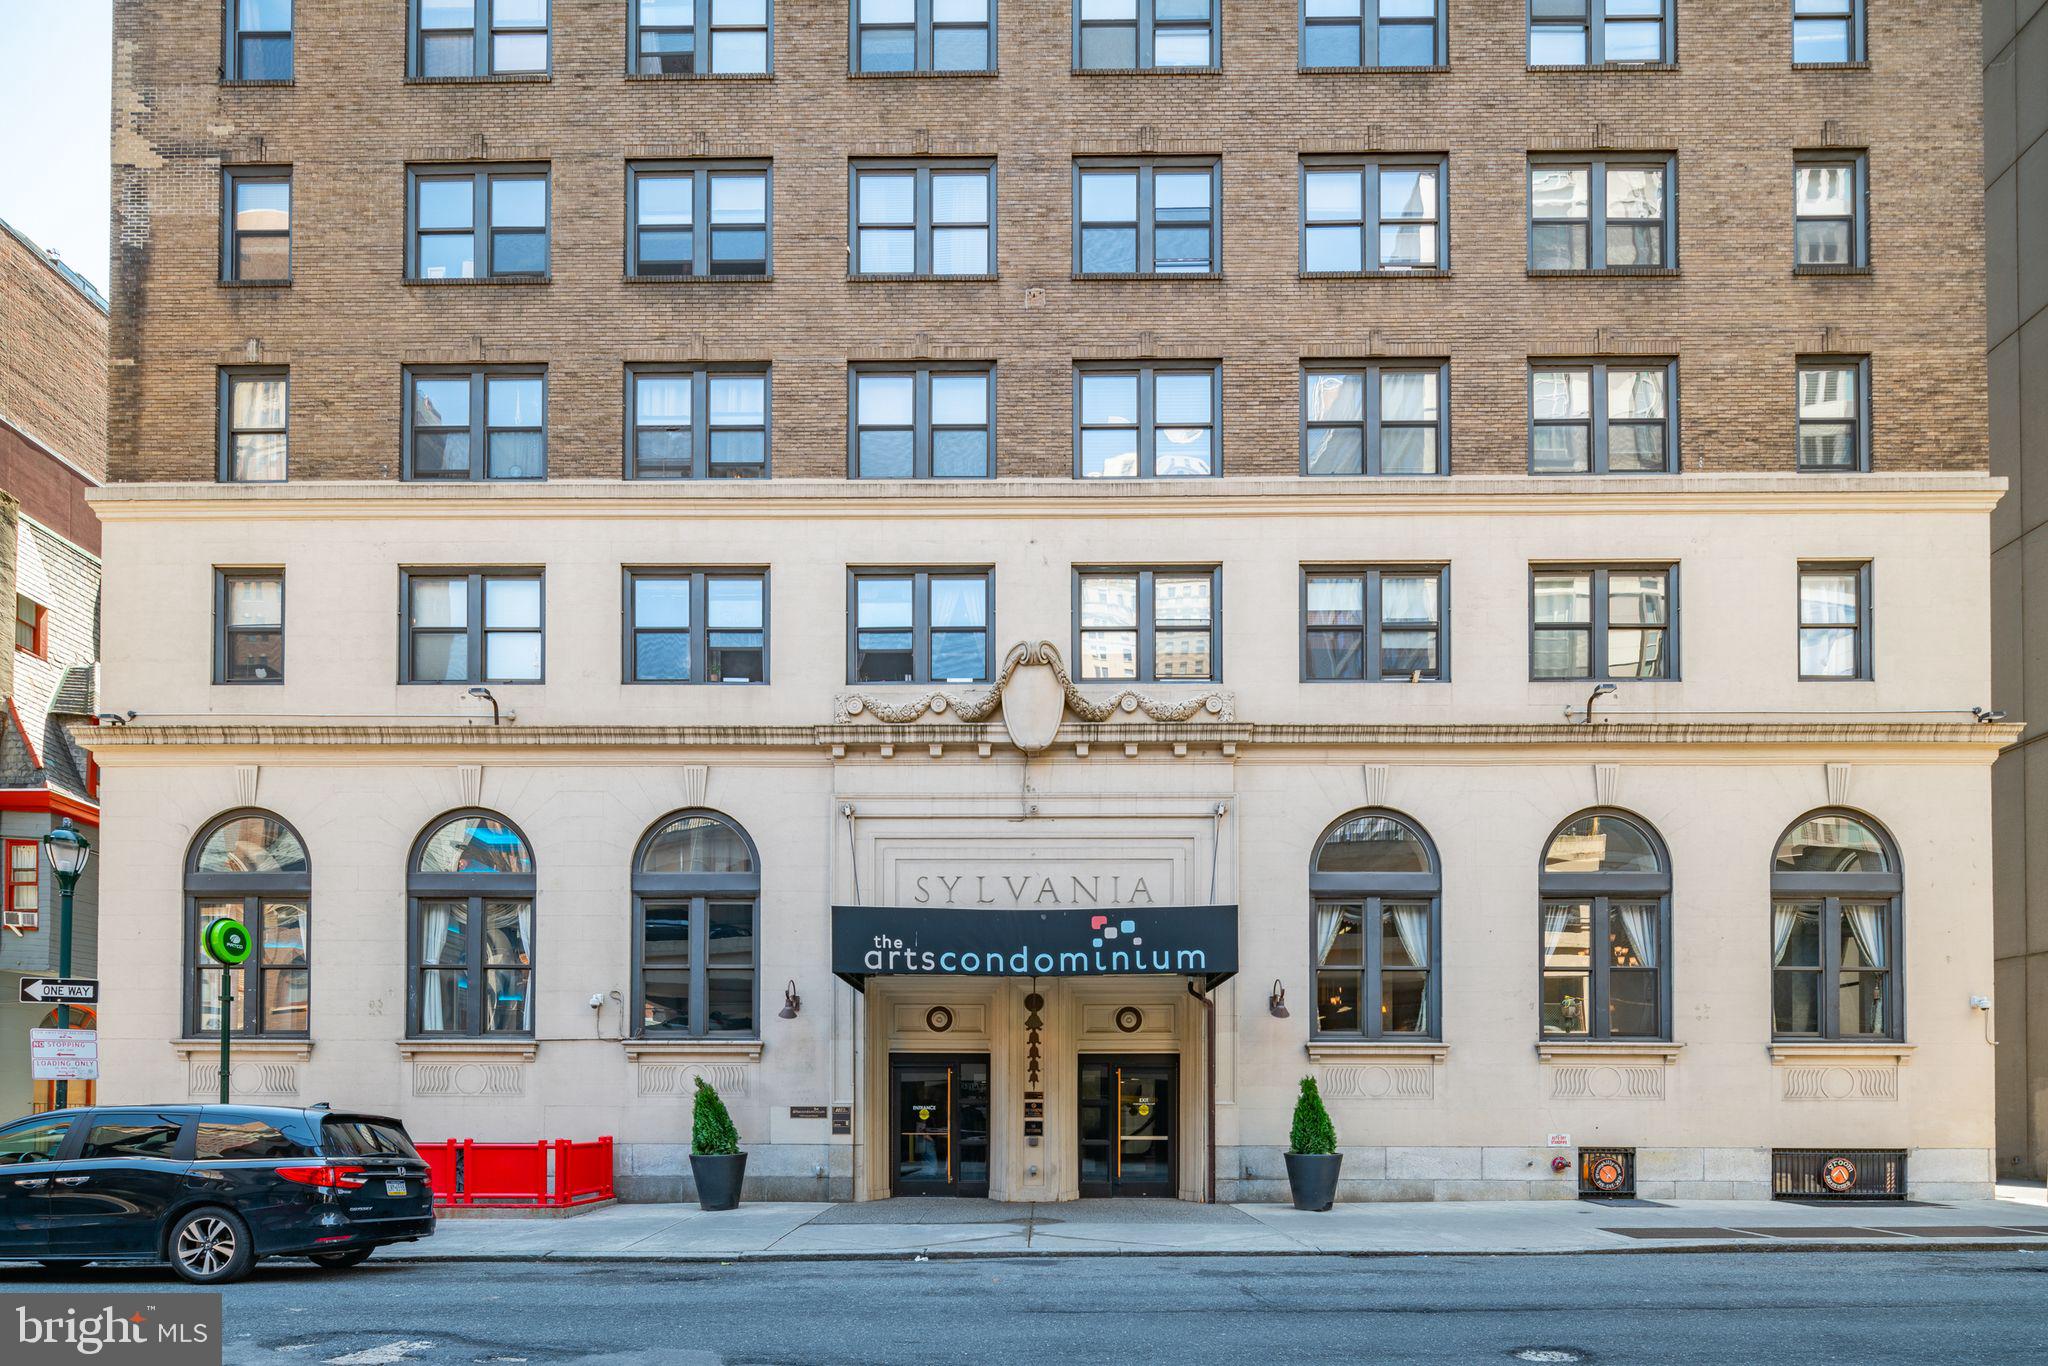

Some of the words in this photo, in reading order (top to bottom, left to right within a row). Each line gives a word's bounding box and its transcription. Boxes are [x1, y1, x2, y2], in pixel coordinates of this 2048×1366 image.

[914, 875, 1154, 904] SYLVANIA
[873, 934, 904, 949] the
[43, 985, 64, 996] ONE
[68, 986, 90, 997] WAY
[33, 1040, 44, 1048] NO
[1827, 1160, 1854, 1173] groom
